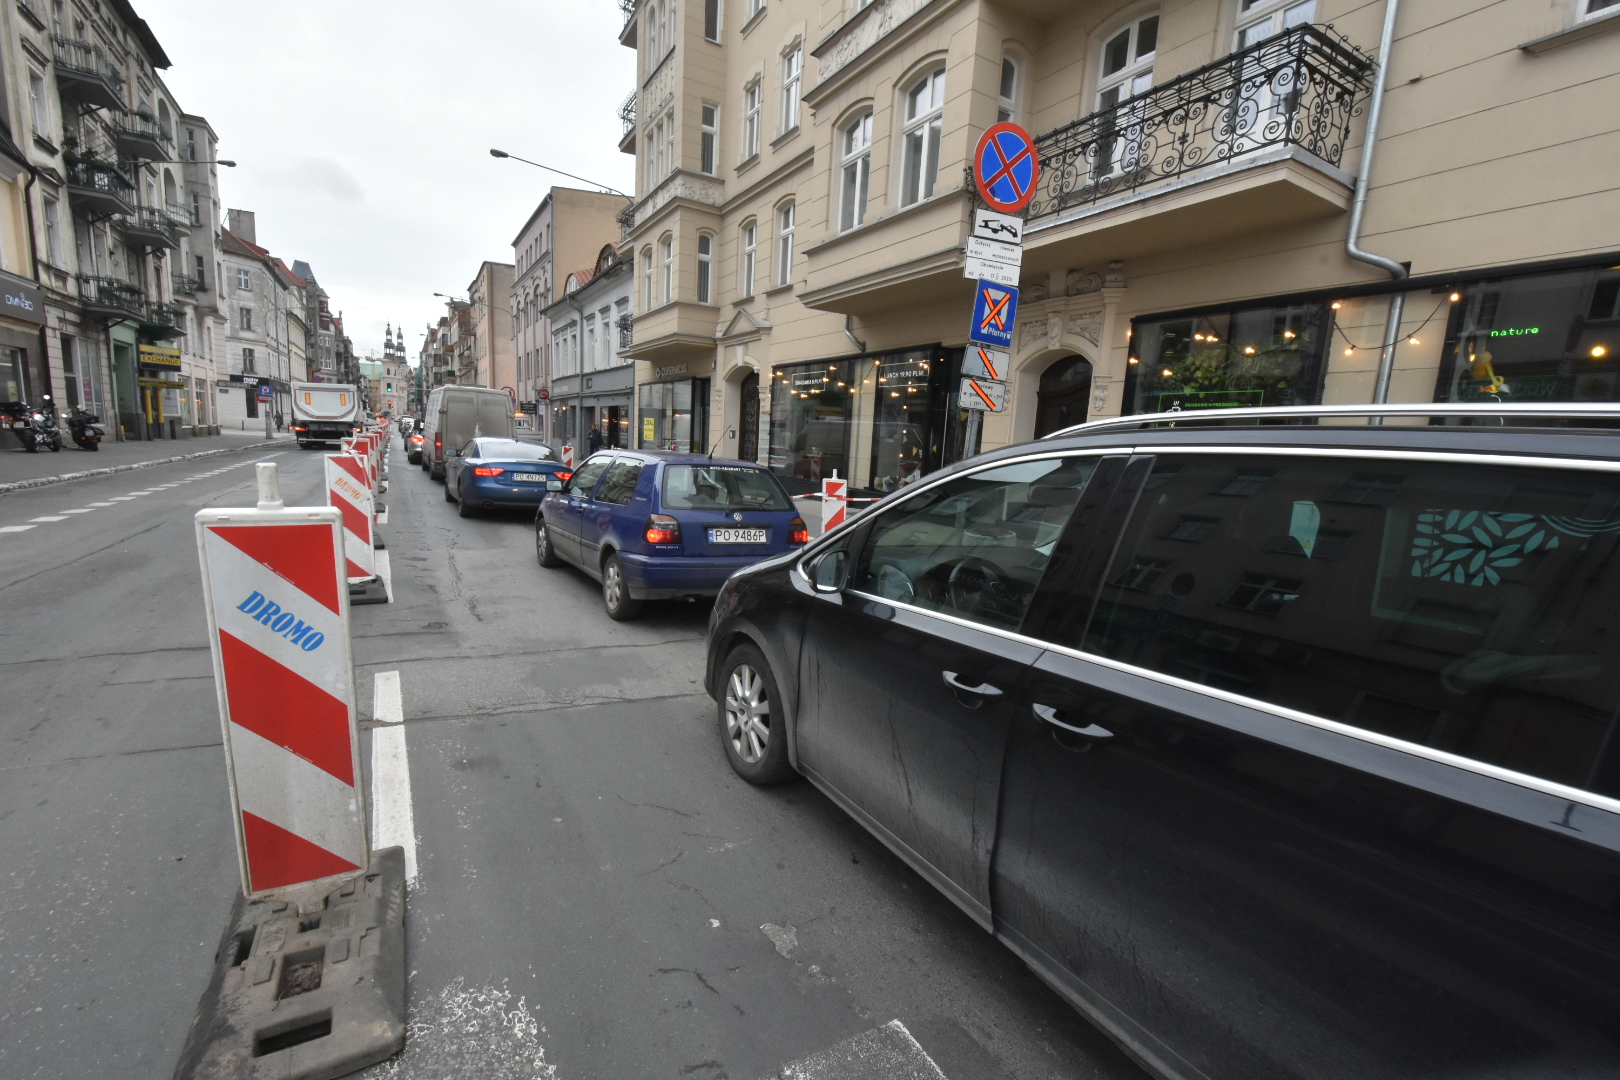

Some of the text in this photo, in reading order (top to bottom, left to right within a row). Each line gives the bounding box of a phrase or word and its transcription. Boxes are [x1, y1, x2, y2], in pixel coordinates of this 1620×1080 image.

[989, 327, 1007, 340] Płatny
[1491, 327, 1539, 337] nature
[142, 356, 179, 364] EXCHANGE
[662, 364, 687, 376] COPERNICUS
[716, 530, 764, 542] PO 9486P
[236, 590, 324, 651] DROMO
